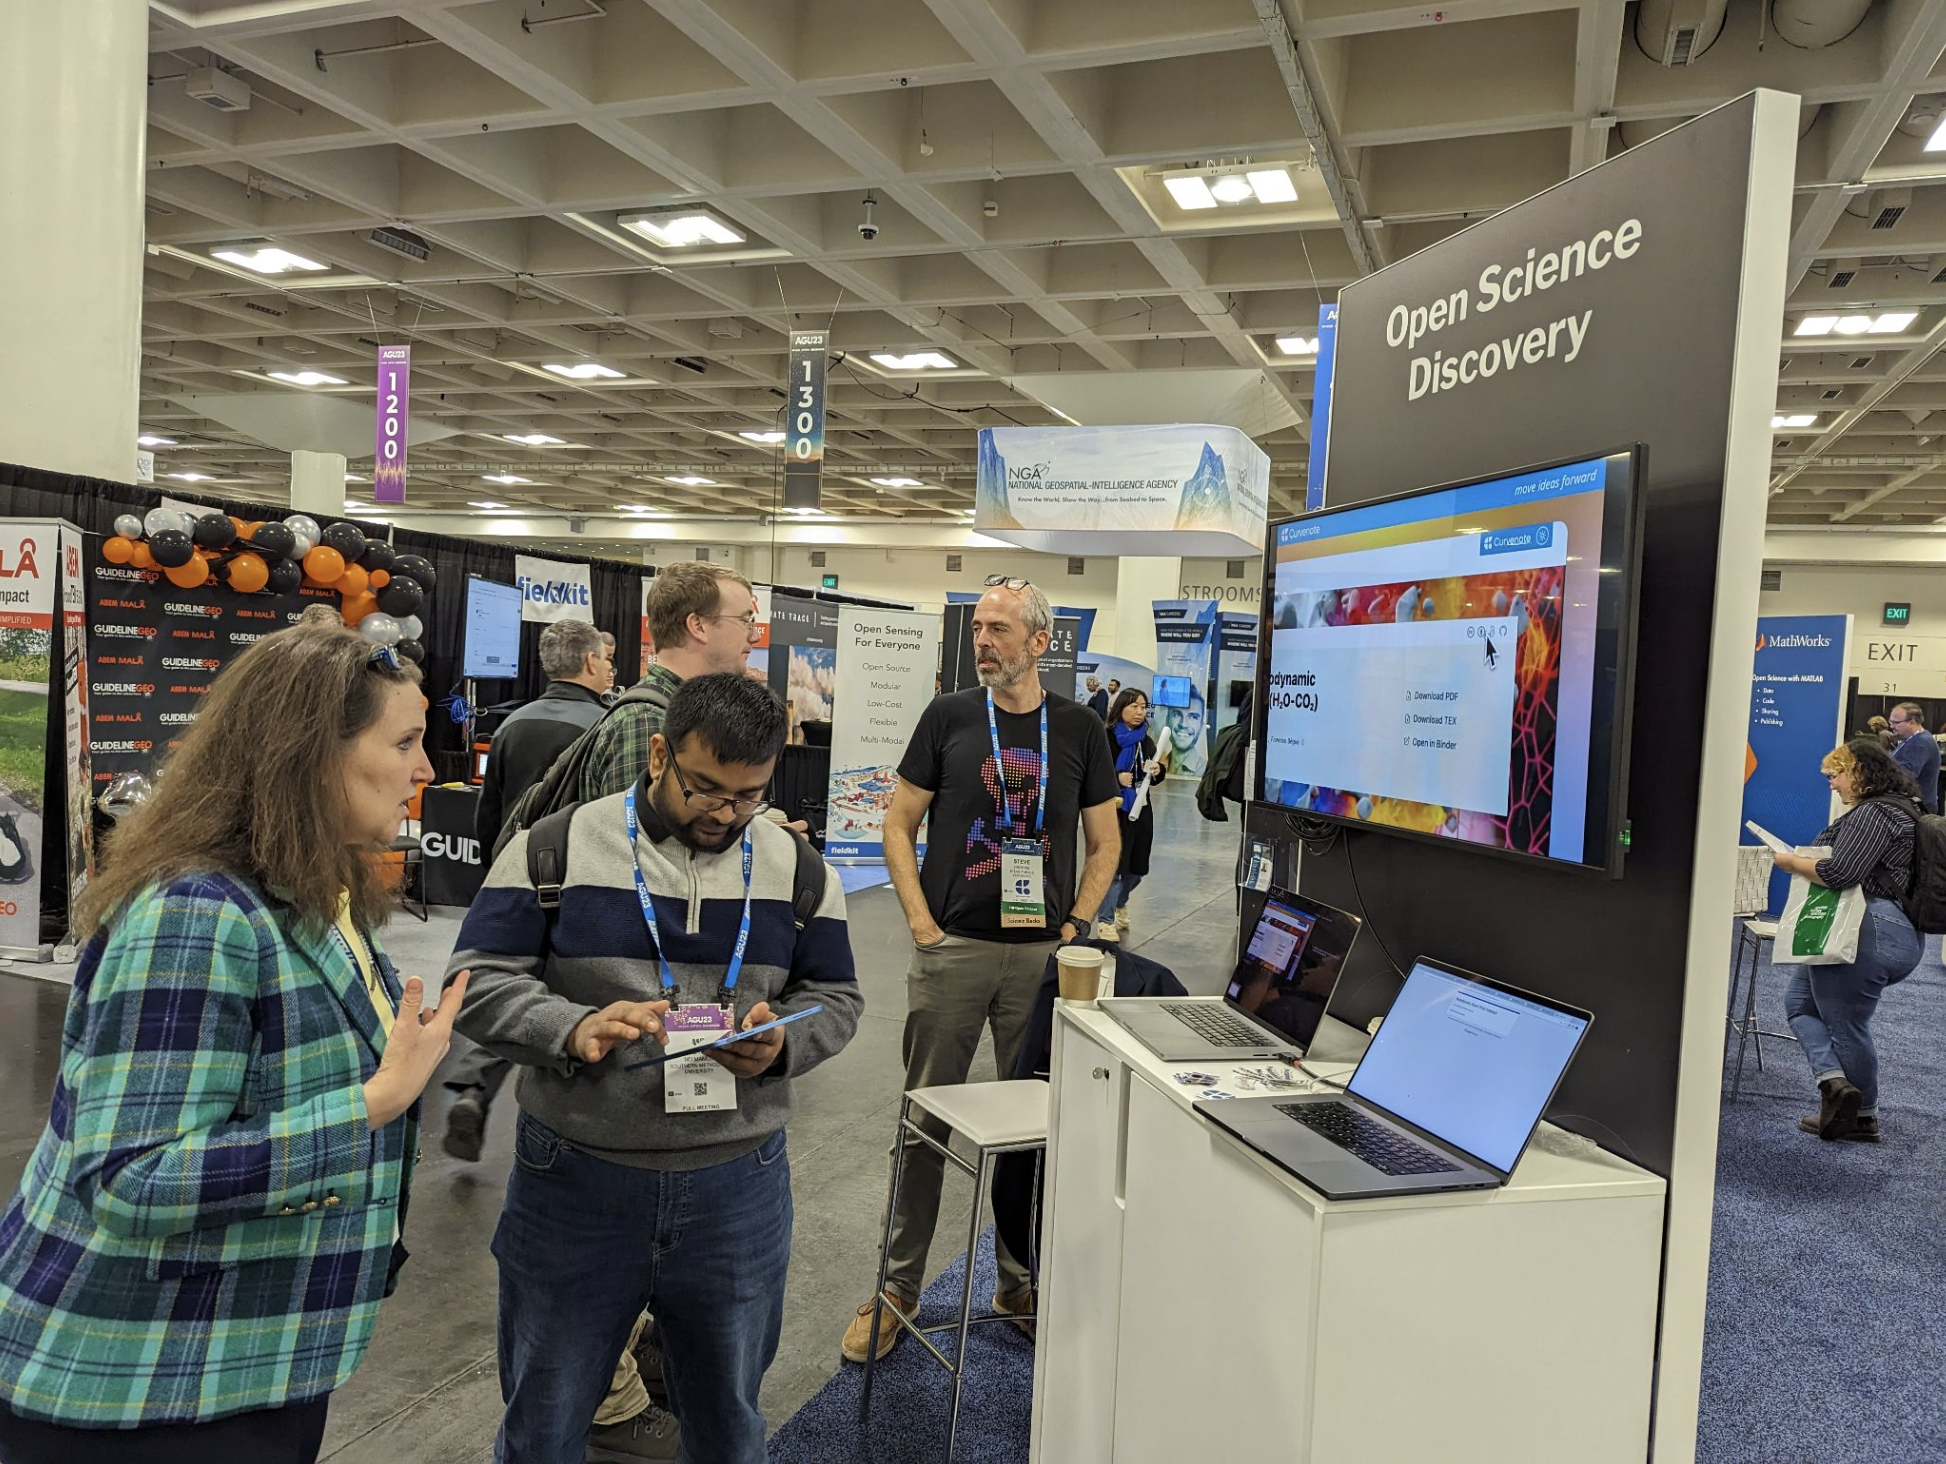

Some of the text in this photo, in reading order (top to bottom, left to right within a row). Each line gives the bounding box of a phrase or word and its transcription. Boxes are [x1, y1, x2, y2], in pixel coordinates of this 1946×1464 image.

[1386, 218, 1642, 350] Open Science
[794, 335, 823, 345] AGU23
[382, 350, 406, 359] AGU23
[1408, 309, 1593, 401] Discovery
[384, 371, 399, 460] 1200
[795, 360, 814, 460] 1300
[1008, 467, 1042, 480] NGA
[1008, 479, 1179, 490] NATIONAL GEOSPATIAL-INTELLIGENCE AGENCY
[1514, 468, 1598, 496] move ideas forward
[1289, 526, 1321, 540] Curvenote
[1493, 534, 1532, 547] Curvenote
[95, 566, 160, 581] GUIDELINEGEO
[823, 578, 836, 587] EXIT
[164, 602, 223, 615] GUIDELINEGEO
[1886, 608, 1908, 619] EXIT
[770, 611, 786, 620] ATE
[788, 613, 810, 623] TRACE
[94, 624, 157, 636] GUIDELINEGEO
[854, 623, 924, 639] Open Sensing
[855, 637, 921, 651] For Everyone
[1769, 634, 1831, 648] MathWorks
[1868, 643, 1919, 662] EXIT
[162, 657, 220, 668] GUIDELINEGEO
[862, 662, 911, 673] Open Source
[1752, 674, 1824, 683] Open Science with MATLAB
[92, 682, 155, 693] GUIDELINEGEO
[870, 681, 902, 690] Modular
[1883, 682, 1897, 693] 31
[1414, 691, 1459, 701] Download PDF
[867, 700, 902, 709] Low-Cost
[869, 717, 898, 727] Flexible
[1413, 714, 1457, 725] Download TEX
[90, 740, 153, 751] GUIDELINEGEO
[860, 735, 905, 745] Multi-Modal
[1412, 737, 1457, 750] Open in Binder
[830, 847, 859, 855] fieldkit
[1013, 858, 1031, 866] STEVE
[636, 881, 652, 909] AGU23
[734, 929, 749, 959] AGU23
[687, 1016, 712, 1024] AGU23
[684, 1067, 714, 1075] UNIVERSITY
